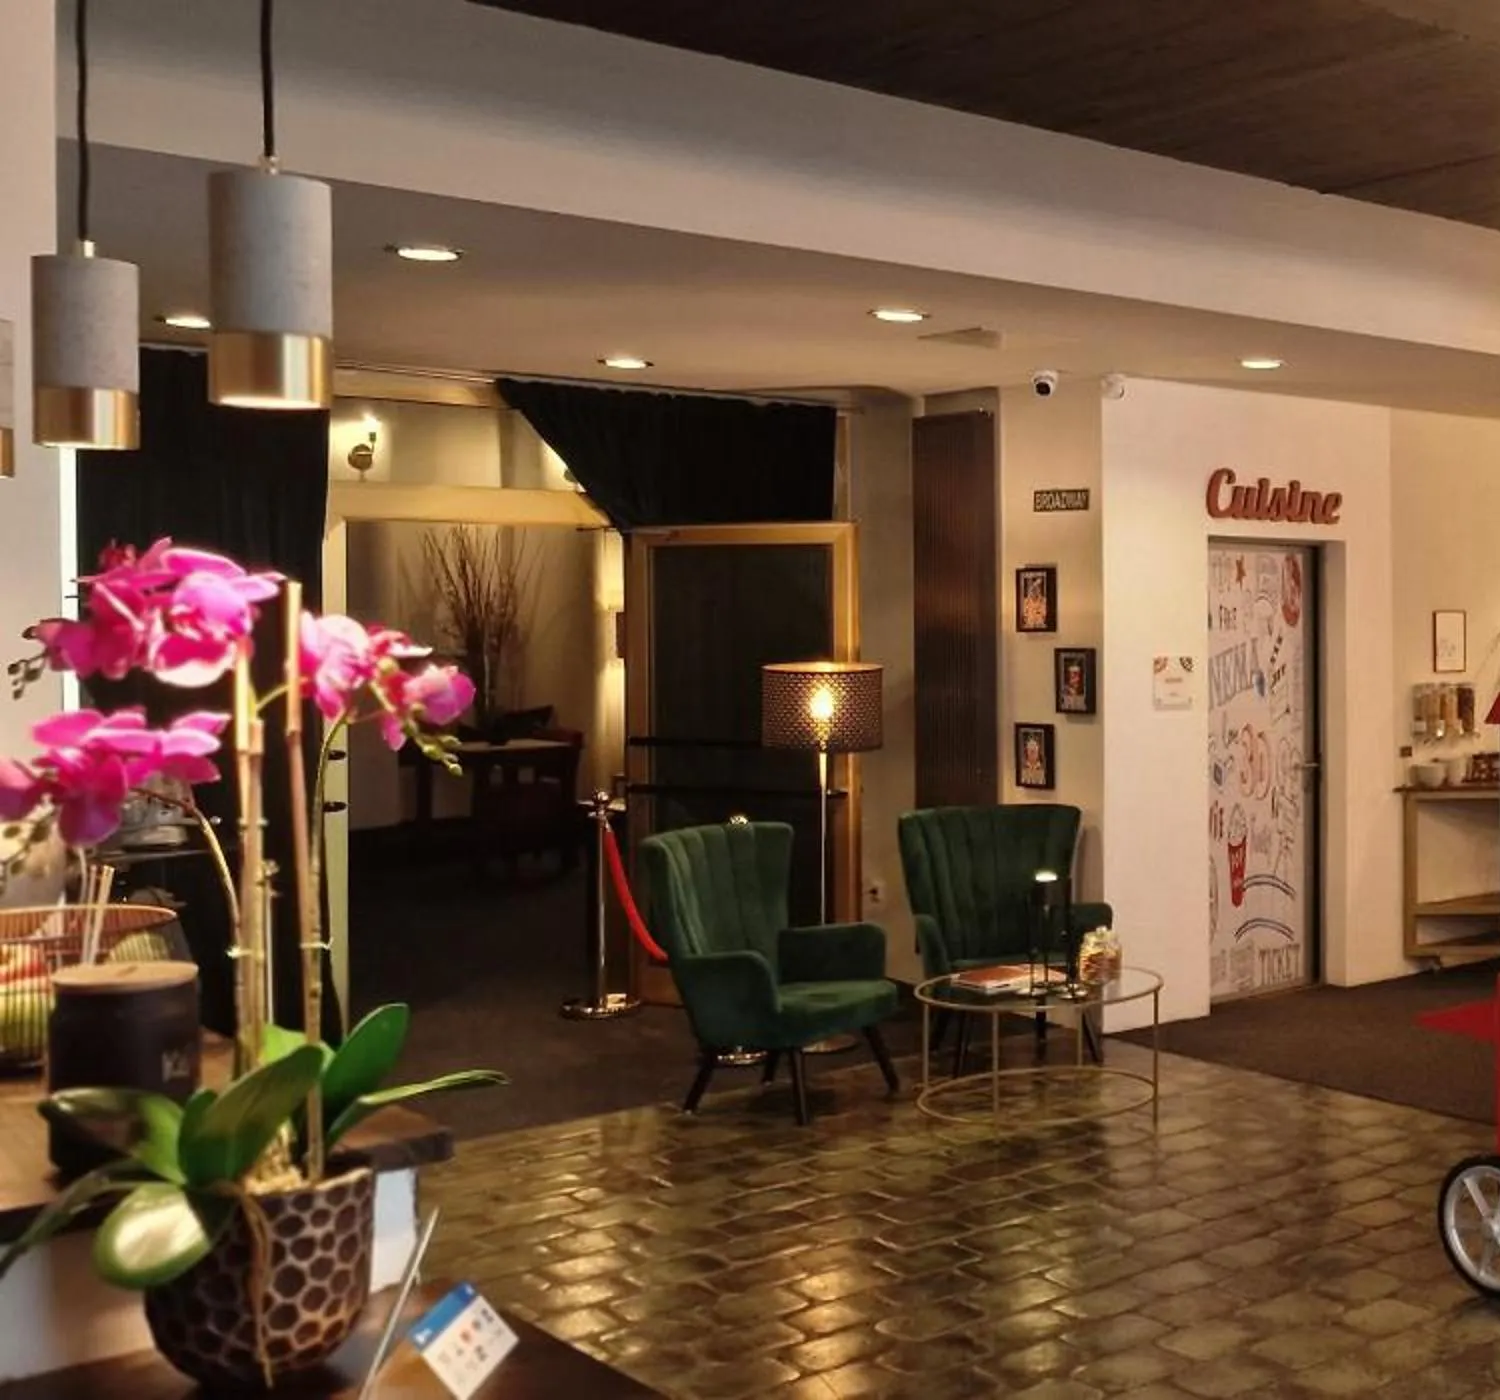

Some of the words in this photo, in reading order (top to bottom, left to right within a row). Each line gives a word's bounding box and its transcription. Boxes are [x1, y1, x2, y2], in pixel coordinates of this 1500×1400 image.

[1035, 491, 1087, 510] BROADWAY
[1206, 468, 1342, 525] Cuisine
[1208, 636, 1258, 710] NEMA
